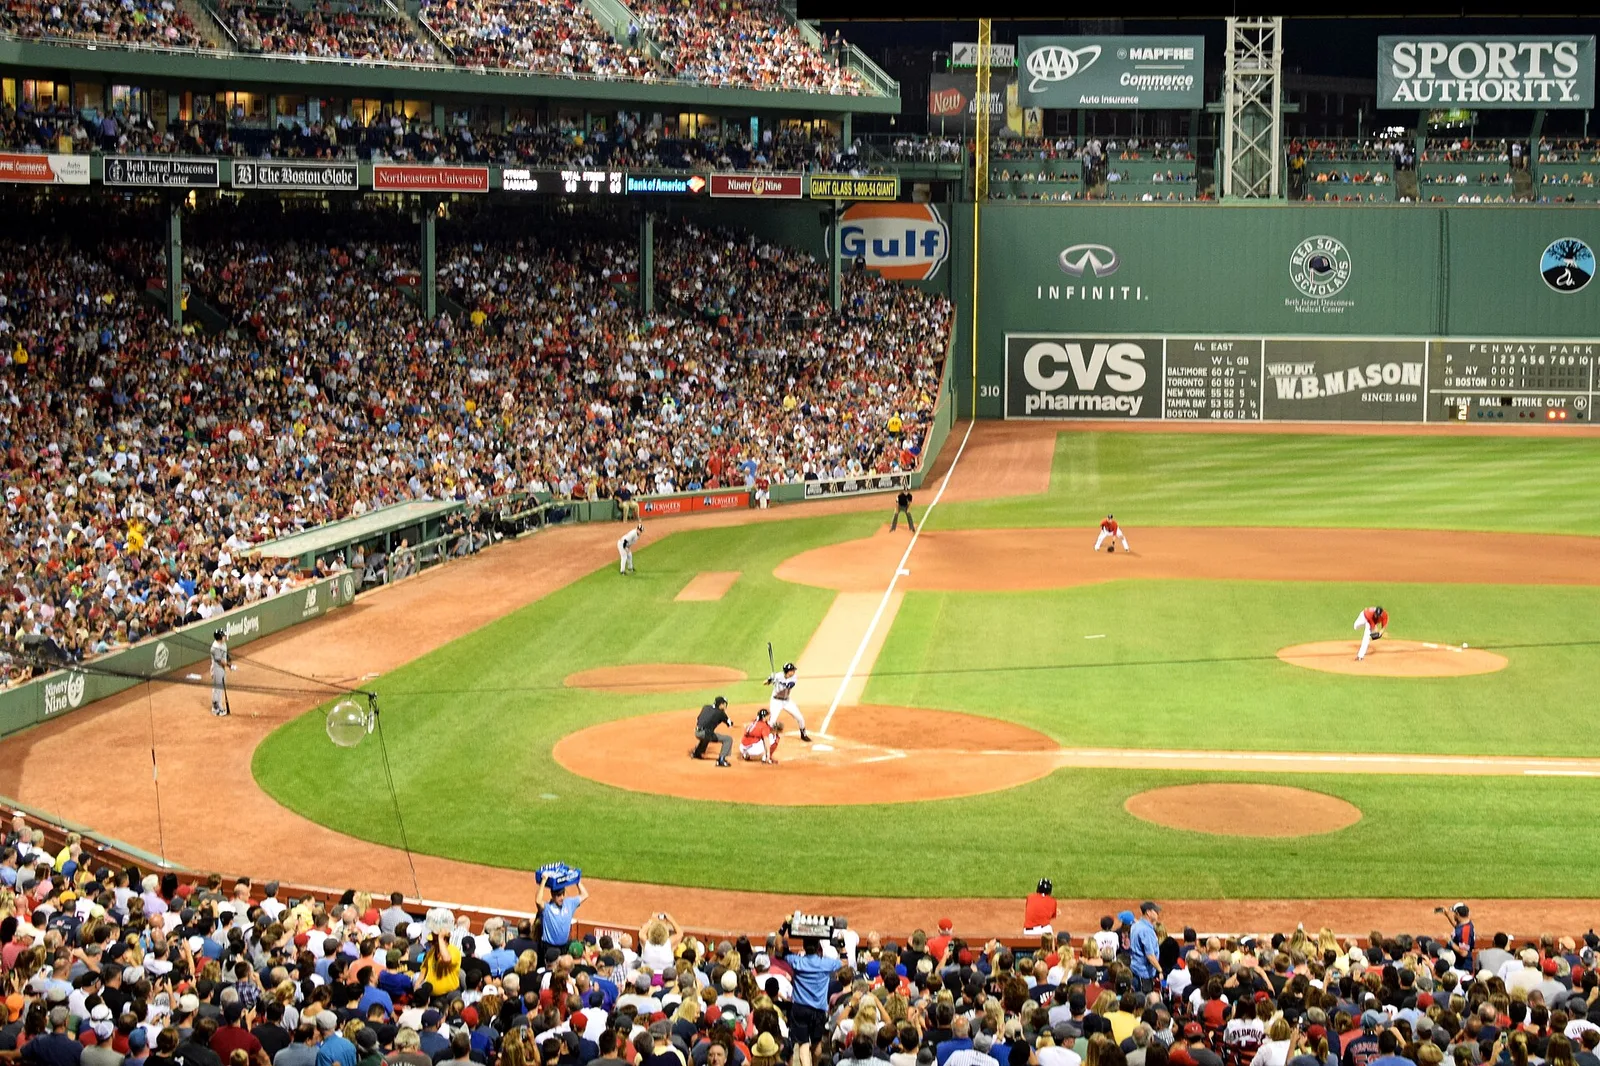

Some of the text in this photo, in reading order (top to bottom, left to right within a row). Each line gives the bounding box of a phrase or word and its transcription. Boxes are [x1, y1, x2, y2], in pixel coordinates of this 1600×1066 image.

[971, 47, 998, 56] CK
[1130, 48, 1194, 60] MAPFRE
[971, 56, 1012, 66] FAGON
[1030, 47, 1076, 79] AAA
[1392, 42, 1578, 78] SPORTS
[1120, 72, 1193, 86] Commerce
[934, 92, 960, 114] New
[1080, 94, 1138, 104] Auto Insurance
[126, 160, 214, 175] Beth Israel Deaconess
[127, 172, 189, 184] Medical Center
[259, 166, 353, 185] The Boston Globe
[379, 171, 484, 187] Northeastern University
[628, 177, 648, 191] Bank
[655, 179, 686, 192] America
[728, 179, 751, 192] Ninety
[765, 180, 781, 191] Nine
[812, 181, 830, 195] GIANT
[832, 181, 852, 195] GLASS
[876, 182, 894, 196] GIANT
[840, 226, 940, 257] Gulf
[1293, 238, 1341, 266] RED SOX
[1295, 261, 1348, 295] SCHOLARS
[1037, 286, 1142, 299] INFINITI
[1194, 342, 1233, 351] AL EAST
[1470, 344, 1592, 354] FENWAY PARK
[1212, 356, 1249, 365] W L GB
[1446, 355, 1452, 364] P
[1500, 355, 1506, 364] 2
[1510, 355, 1515, 364] 3
[1521, 355, 1527, 364] 4
[1530, 355, 1536, 364] 5
[1538, 356, 1545, 364] 6
[1550, 356, 1556, 364] 7
[1560, 356, 1565, 365] 8
[1568, 356, 1574, 365] 9
[1579, 356, 1588, 365] 10
[1023, 342, 1146, 392] CVS
[1167, 367, 1234, 376] BALTIMORE 60 47
[1267, 365, 1314, 376] WHO BUT
[1466, 366, 1478, 375] NY
[1492, 366, 1496, 375] 0
[1500, 366, 1505, 375] 0
[1509, 366, 1514, 376] 0
[1167, 378, 1204, 387] TORONTO
[1211, 378, 1221, 387] 60
[1224, 378, 1234, 387] 50
[1445, 377, 1452, 386] 63
[1456, 377, 1487, 387] BOSTON
[1491, 378, 1496, 387] 0
[1500, 378, 1505, 387] 0
[1509, 378, 1513, 387] 2
[980, 386, 999, 397] 310
[1167, 388, 1244, 398] NEW YORK 55 52 5
[1026, 390, 1143, 416] pharmacy
[1167, 399, 1190, 408] TAMPA
[1192, 399, 1206, 408] BAY
[1211, 399, 1221, 408] 53
[1224, 399, 1234, 408] 55
[1240, 399, 1244, 408] 7
[1362, 393, 1417, 403] SINCE 1898
[1444, 397, 1454, 406] AT
[1457, 397, 1471, 406] BAT
[1480, 397, 1501, 406] BALL
[1512, 397, 1542, 407] STRIKE
[1546, 398, 1566, 407] OUT
[1166, 409, 1198, 418] BOSTON
[1211, 410, 1221, 419] 48
[1223, 410, 1233, 419] 60
[1238, 410, 1246, 419] 12
[45, 680, 67, 698] Ninety
[45, 694, 67, 715] Nine
